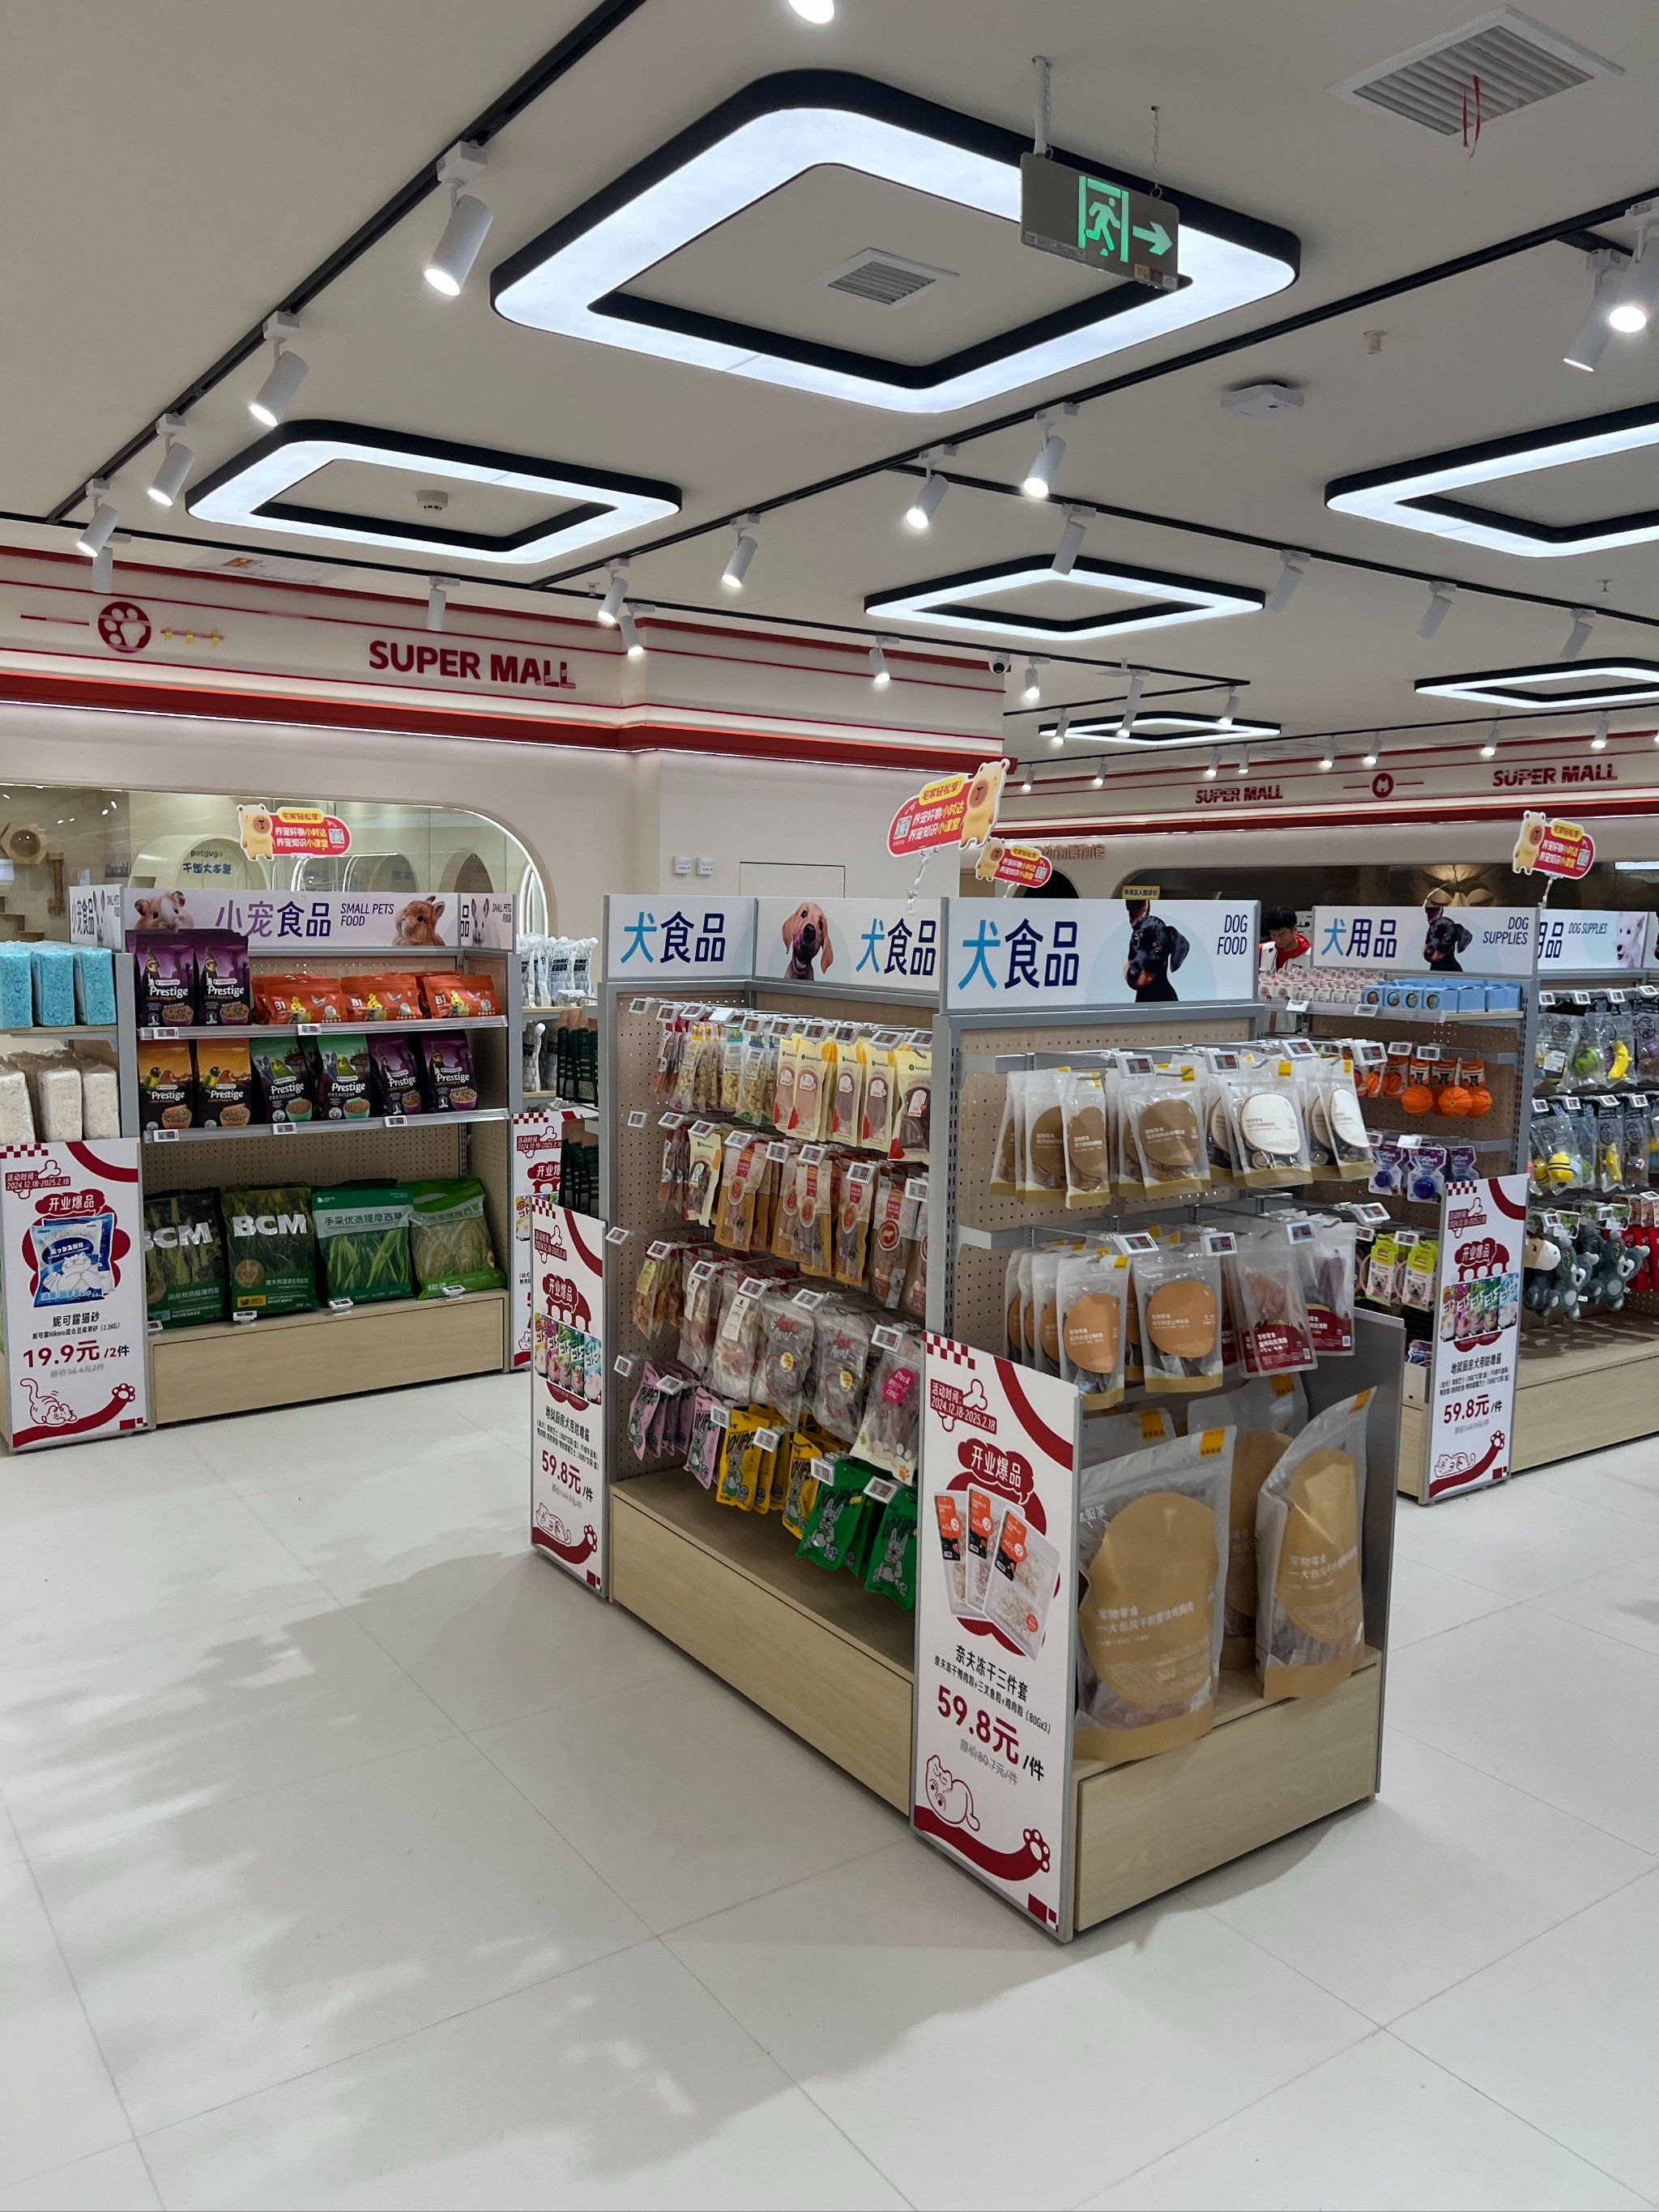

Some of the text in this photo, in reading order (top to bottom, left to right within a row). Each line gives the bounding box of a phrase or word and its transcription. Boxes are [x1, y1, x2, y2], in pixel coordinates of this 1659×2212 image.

[369, 640, 577, 689] SUPER MALL
[1493, 764, 1618, 786] SUPER MALL
[1195, 785, 1283, 804] SUPER MALL
[340, 902, 394, 914] SMALL PETS
[215, 899, 332, 938] 小宠食品
[340, 915, 365, 927] FOOD
[1224, 914, 1248, 933] DOG
[1508, 916, 1529, 930] DOG
[620, 910, 726, 964] 犬食品
[1482, 931, 1529, 944] SUPPLIES
[1568, 922, 1608, 935] DOG SUPPLIES
[855, 918, 936, 976] 犬食品
[1217, 936, 1247, 955] FOOD
[1320, 917, 1398, 959] 犬用品
[957, 918, 1079, 991] 犬食品
[149, 985, 188, 998] Prestige
[207, 984, 245, 997] Prestige
[437, 1072, 470, 1082] Prestige
[151, 1090, 185, 1102] Prestige
[211, 1090, 244, 1101] Prestige
[271, 1082, 305, 1095] Prestige
[331, 1081, 366, 1093] Prestige
[7, 1177, 70, 1190] 2024.12.18-2025.2.18
[49, 1194, 95, 1212] 开业爆品
[232, 1213, 308, 1237] BCM
[325, 1212, 404, 1226] 手采优选提摩西草
[548, 1277, 573, 1302] 开业爆品
[53, 1311, 100, 1328] 妮可露猫砂
[931, 1396, 996, 1431] 2024.12.18-2025.2.18
[970, 1445, 1021, 1489] 开业爆品
[956, 1644, 1028, 1702] 奈夫冻干三件套
